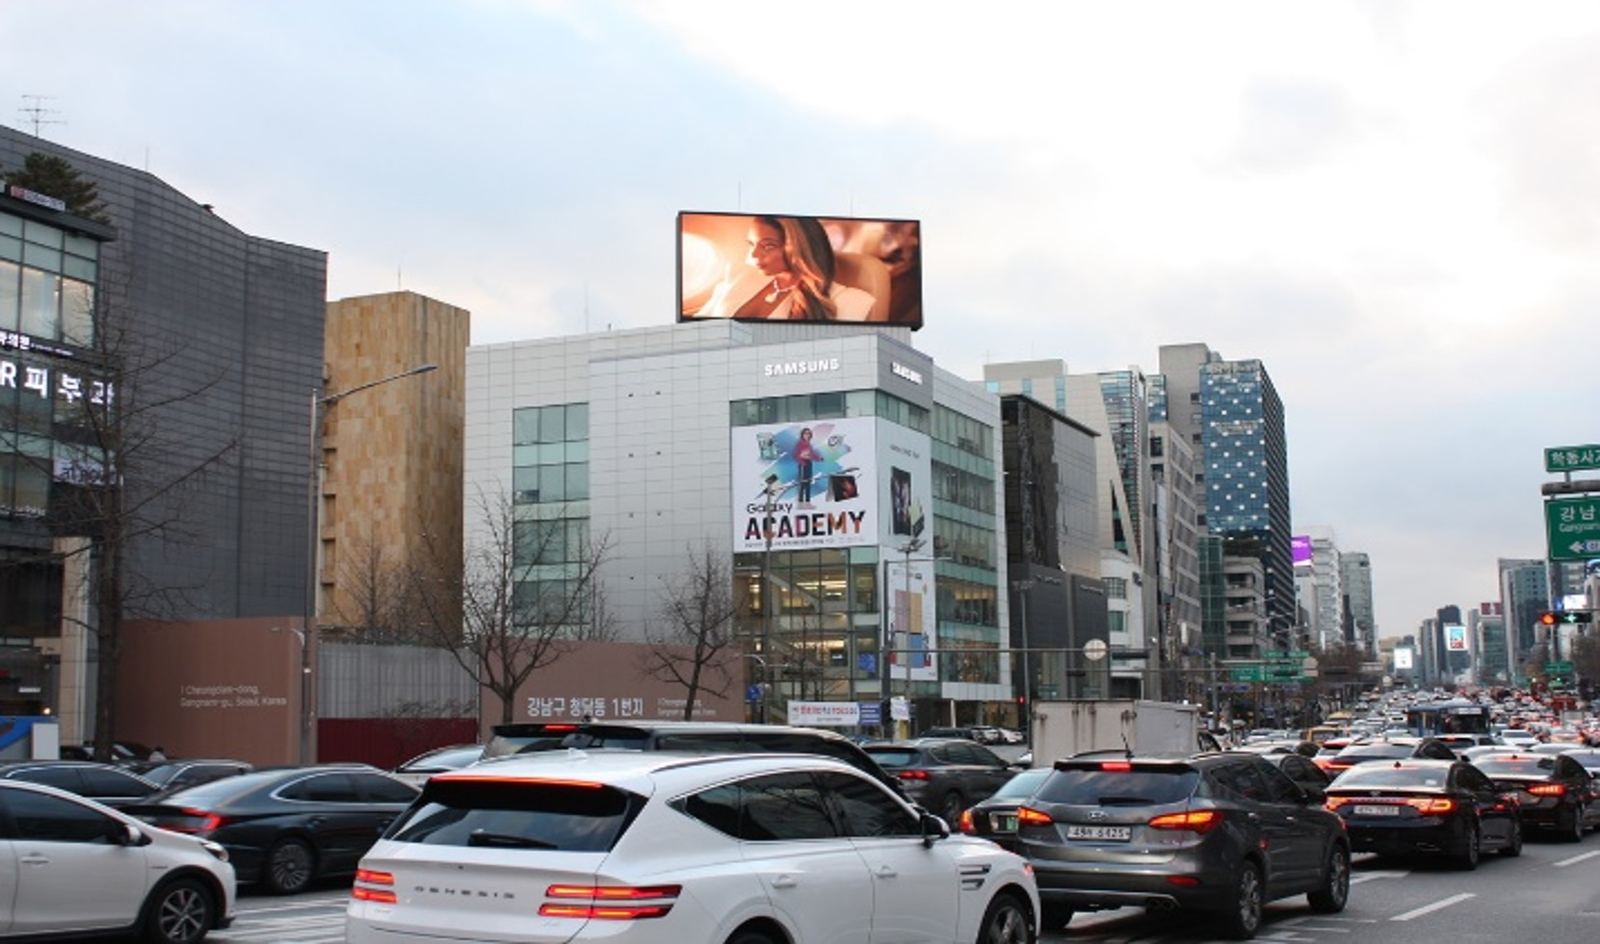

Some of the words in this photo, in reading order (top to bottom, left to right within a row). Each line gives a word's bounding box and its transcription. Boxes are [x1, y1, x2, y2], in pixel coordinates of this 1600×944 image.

[765, 358, 840, 376] SAMSUNG
[747, 503, 793, 514] Gaaxy
[744, 511, 866, 540] ACADEMY
[528, 697, 566, 717] 강남구
[570, 697, 606, 717] 청담동
[612, 697, 644, 717] 1번지
